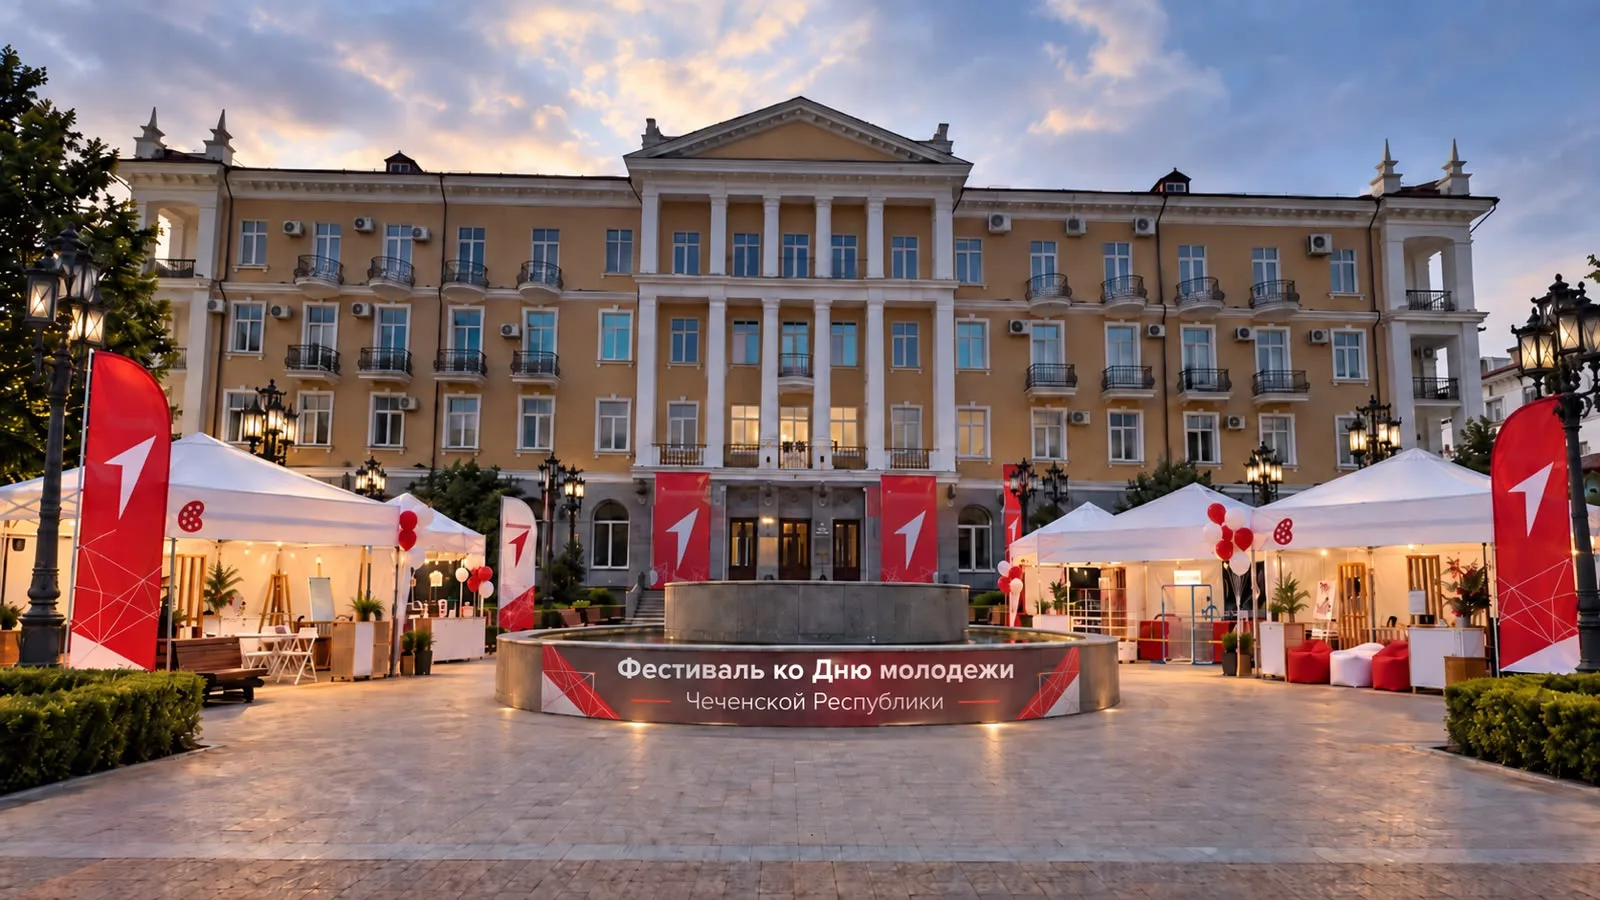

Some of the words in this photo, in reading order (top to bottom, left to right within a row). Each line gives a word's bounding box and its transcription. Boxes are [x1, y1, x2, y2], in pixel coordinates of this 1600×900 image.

[617, 656, 766, 680] Фестиваль
[773, 663, 805, 680] ко
[811, 658, 872, 684] Дню
[879, 663, 1014, 683] молодежи
[686, 691, 806, 711] Чеченской
[813, 691, 944, 716] Республики
